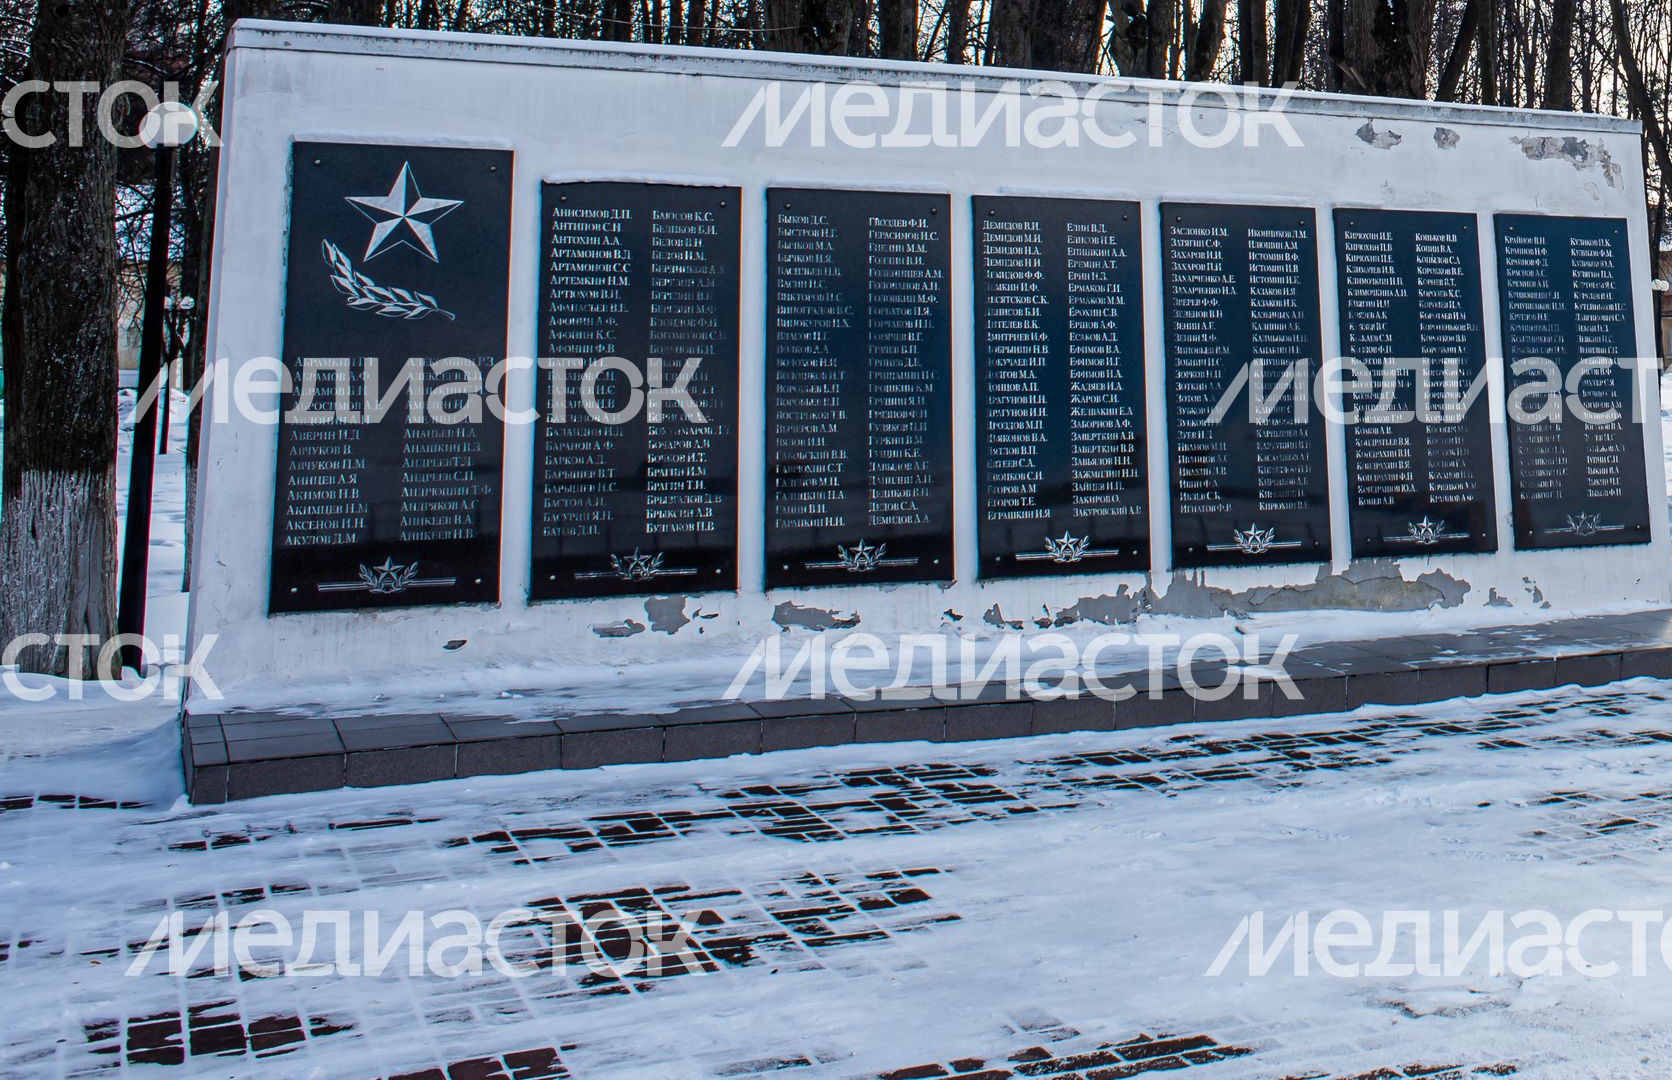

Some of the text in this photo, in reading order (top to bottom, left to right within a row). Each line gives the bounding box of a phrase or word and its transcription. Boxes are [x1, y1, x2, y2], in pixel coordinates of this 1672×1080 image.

[553, 207, 609, 218] АНИСИМОВ
[552, 234, 600, 244] АНТОХИН
[551, 248, 612, 259] АРТАМОНОВ
[1112, 248, 1127, 257] А.А.
[1171, 250, 1205, 259] ЗАХАРОВ
[551, 261, 611, 272] АРТАМОНОВ
[1103, 260, 1117, 268] А.Т.
[1100, 320, 1117, 329] А.Ф.
[1071, 394, 1101, 403] ЖАРОВ
[286, 520, 339, 530] АКСЕНОВ
